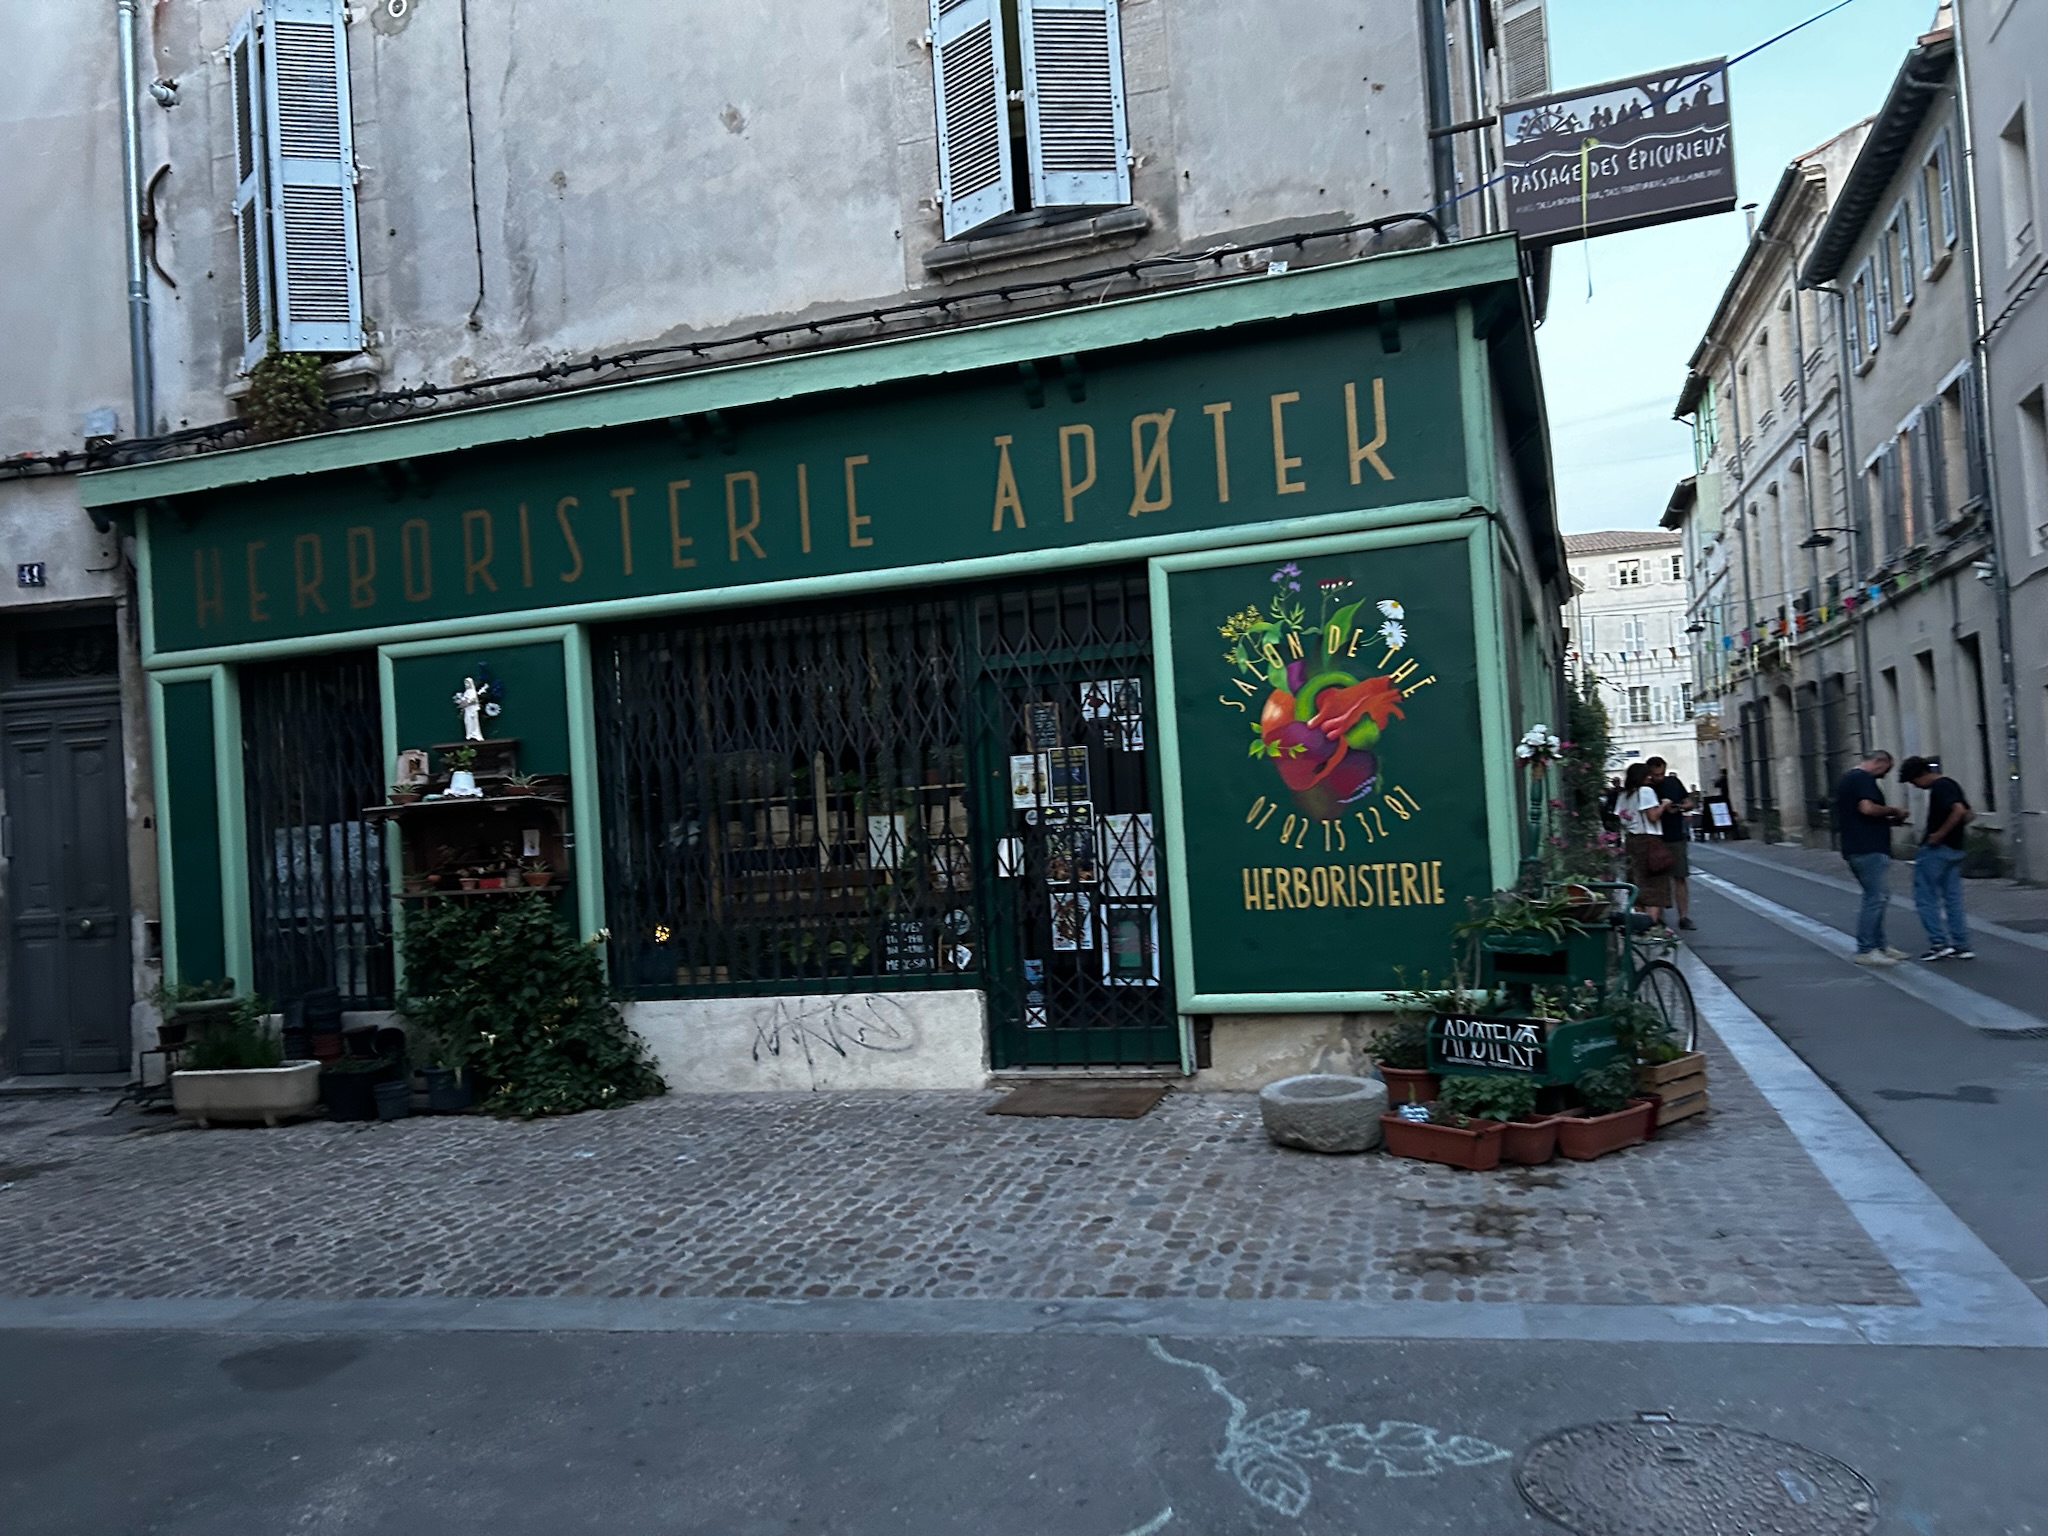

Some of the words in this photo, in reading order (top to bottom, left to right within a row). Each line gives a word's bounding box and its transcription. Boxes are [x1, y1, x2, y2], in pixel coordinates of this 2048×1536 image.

[1511, 163, 1582, 195] PASSAGE
[1590, 154, 1620, 179] DES
[1628, 133, 1728, 170] ÉPICURIEUX
[194, 455, 873, 629] HERBORISTERIE
[1219, 631, 1304, 713] SALON
[1328, 625, 1363, 657] DE
[1377, 644, 1437, 698] THÉ
[1242, 861, 1445, 910] HERBORISTERIE
